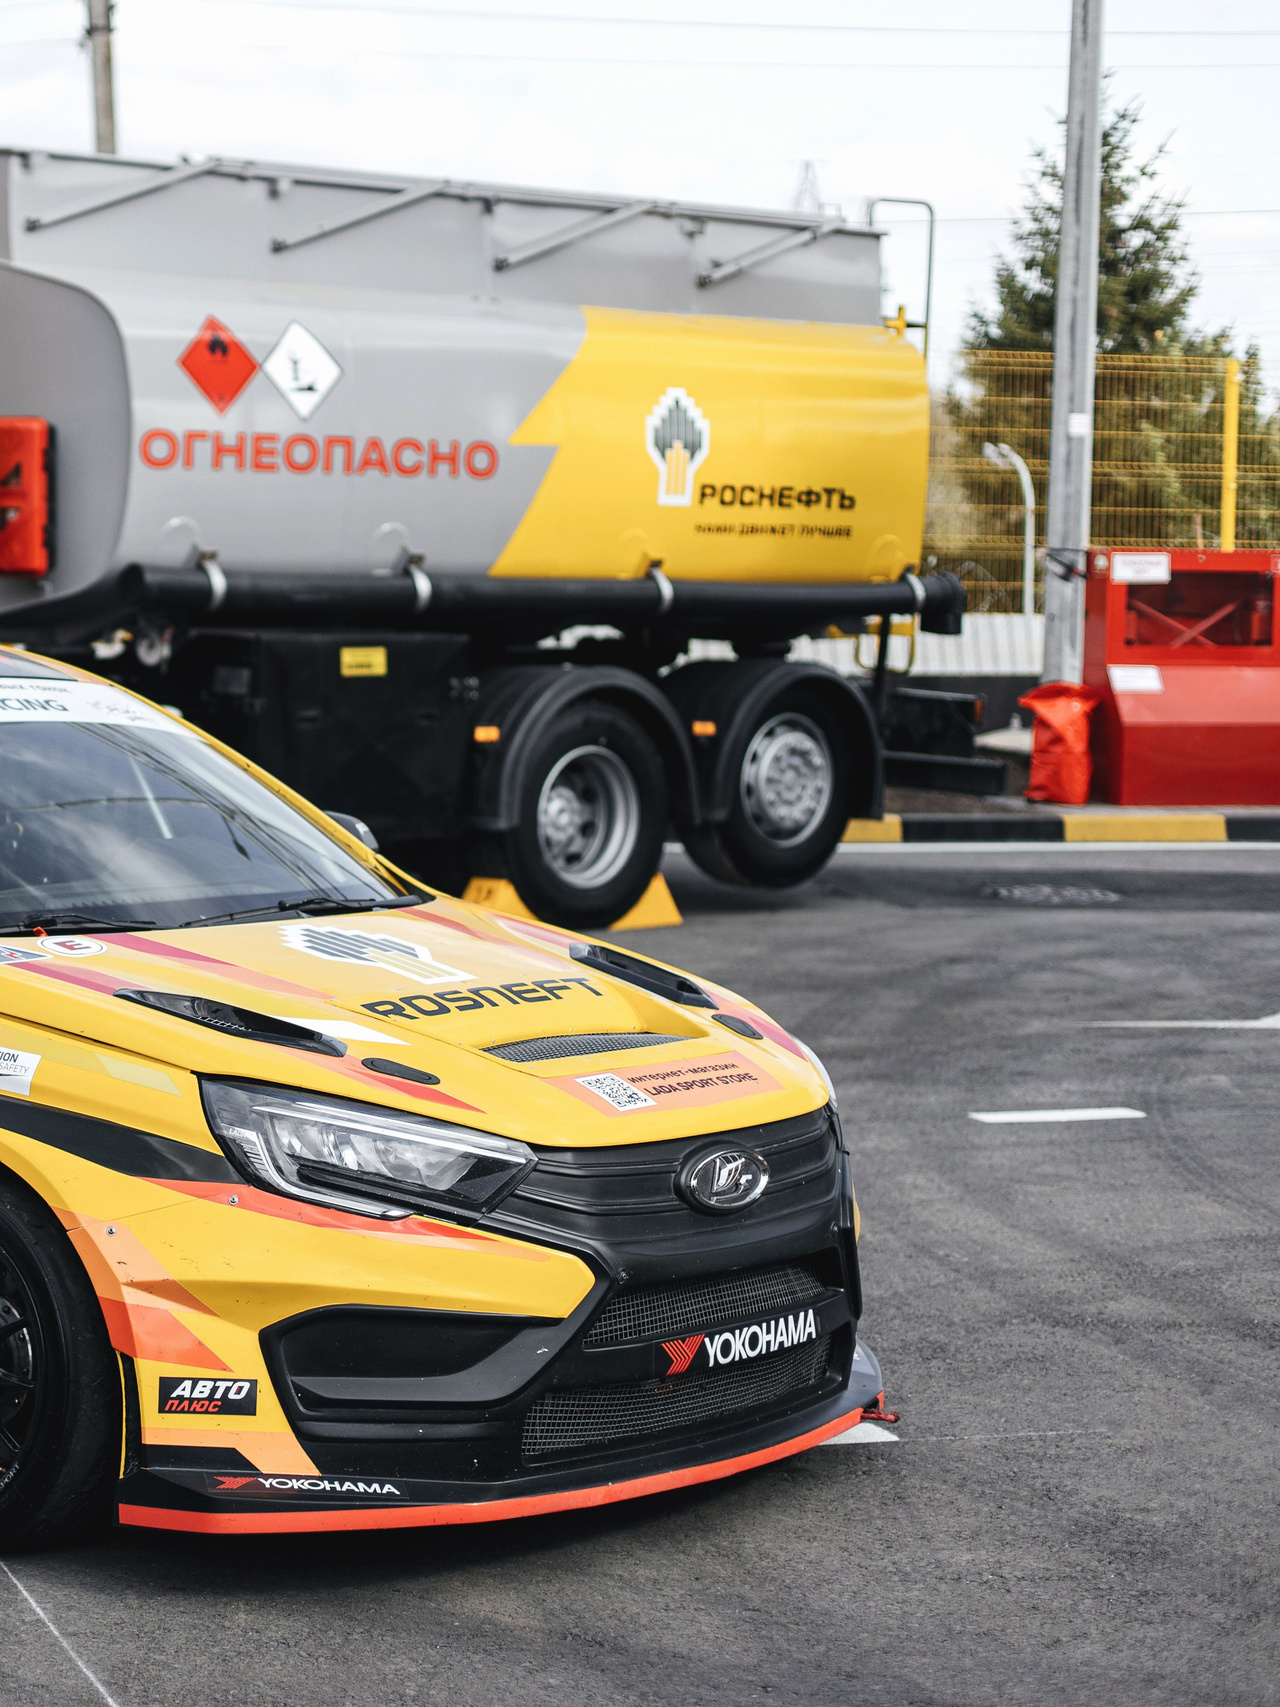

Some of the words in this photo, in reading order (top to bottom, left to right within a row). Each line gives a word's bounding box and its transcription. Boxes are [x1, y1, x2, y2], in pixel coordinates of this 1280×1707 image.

[139, 428, 499, 479] ОГНЕОПАСНО
[698, 484, 856, 510] РОСНЕФТЬ
[360, 977, 604, 1021] ROSNEFT
[644, 1082, 680, 1097] LADA
[679, 1077, 720, 1092] SPORT
[721, 1072, 759, 1086] STORE
[704, 1308, 817, 1368] YOKOHAMA
[170, 1380, 251, 1400] АВТО
[164, 1400, 222, 1413] ПЛЮС
[257, 1477, 401, 1495] YOKOHAMA
